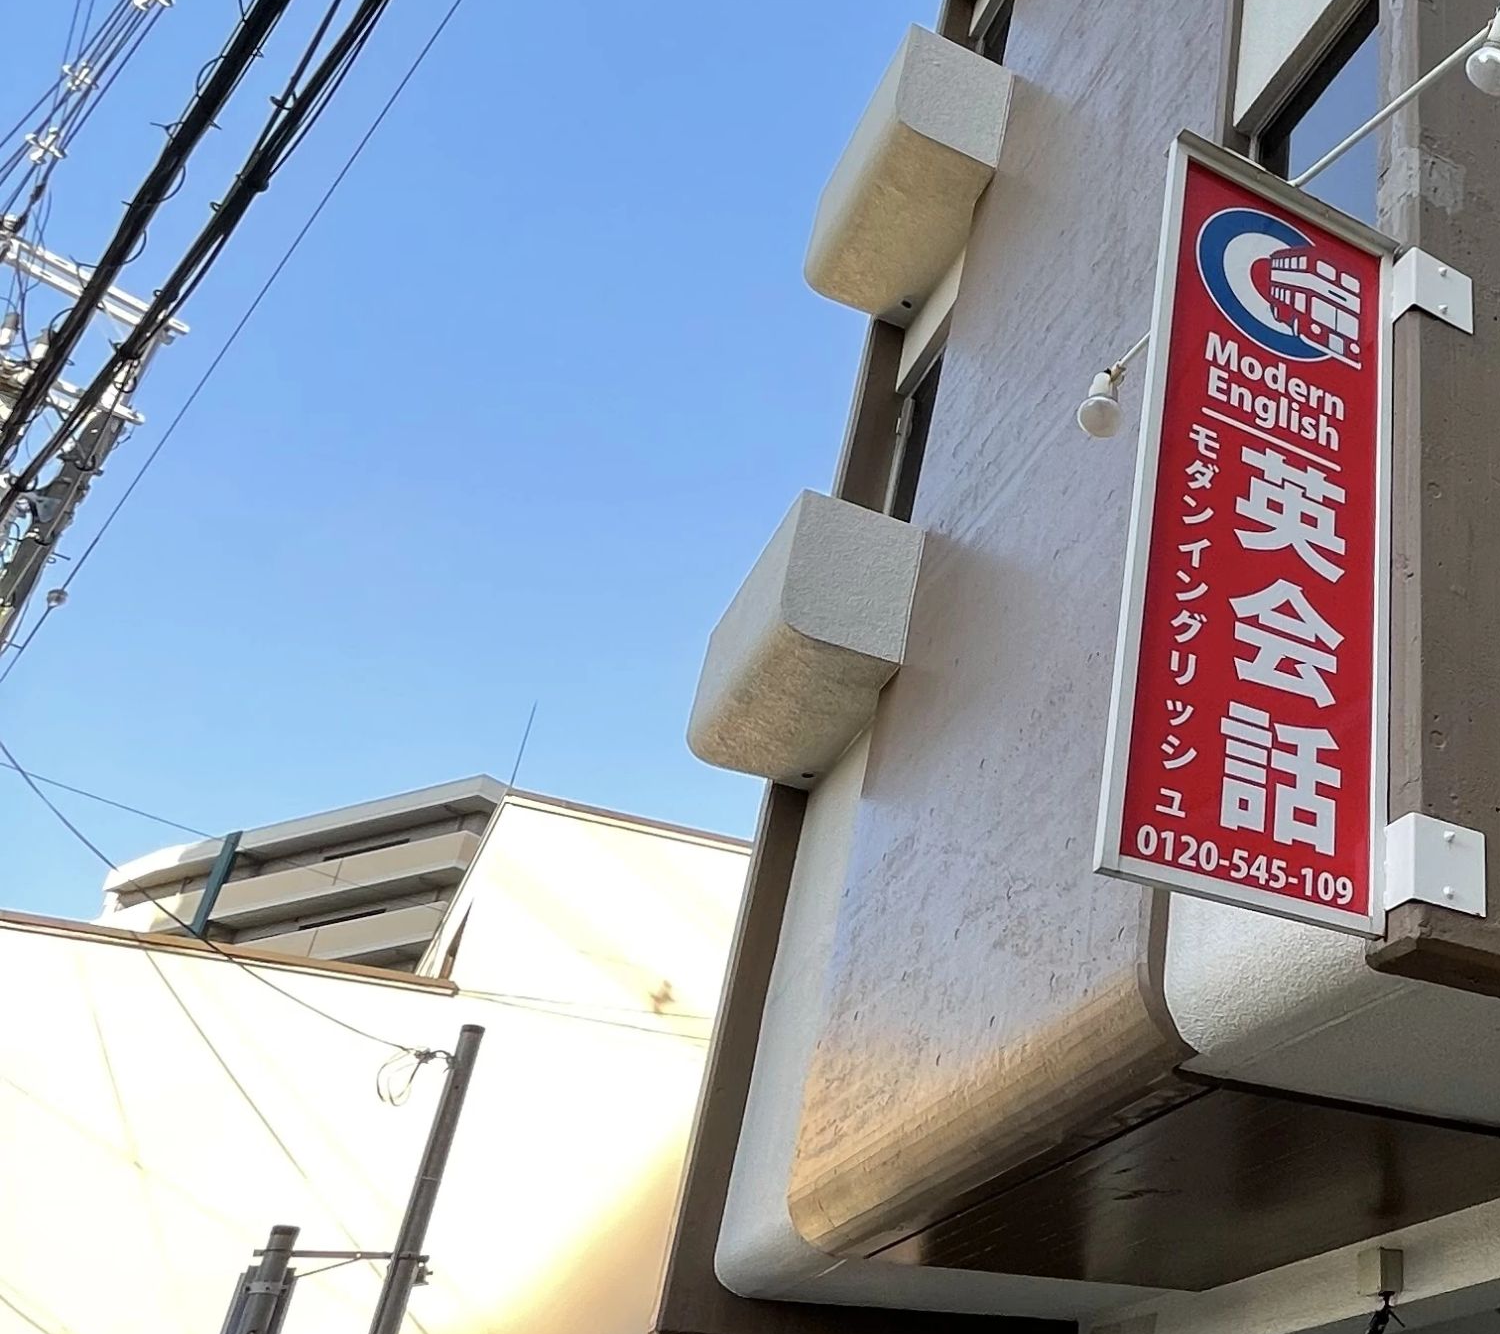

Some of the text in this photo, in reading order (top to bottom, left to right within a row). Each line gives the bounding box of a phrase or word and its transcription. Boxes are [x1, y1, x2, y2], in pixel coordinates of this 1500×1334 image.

[1204, 332, 1345, 421] Modern
[1207, 370, 1340, 451] English
[1219, 445, 1347, 857] 英会話
[1136, 823, 1354, 906] 0120-545-109
